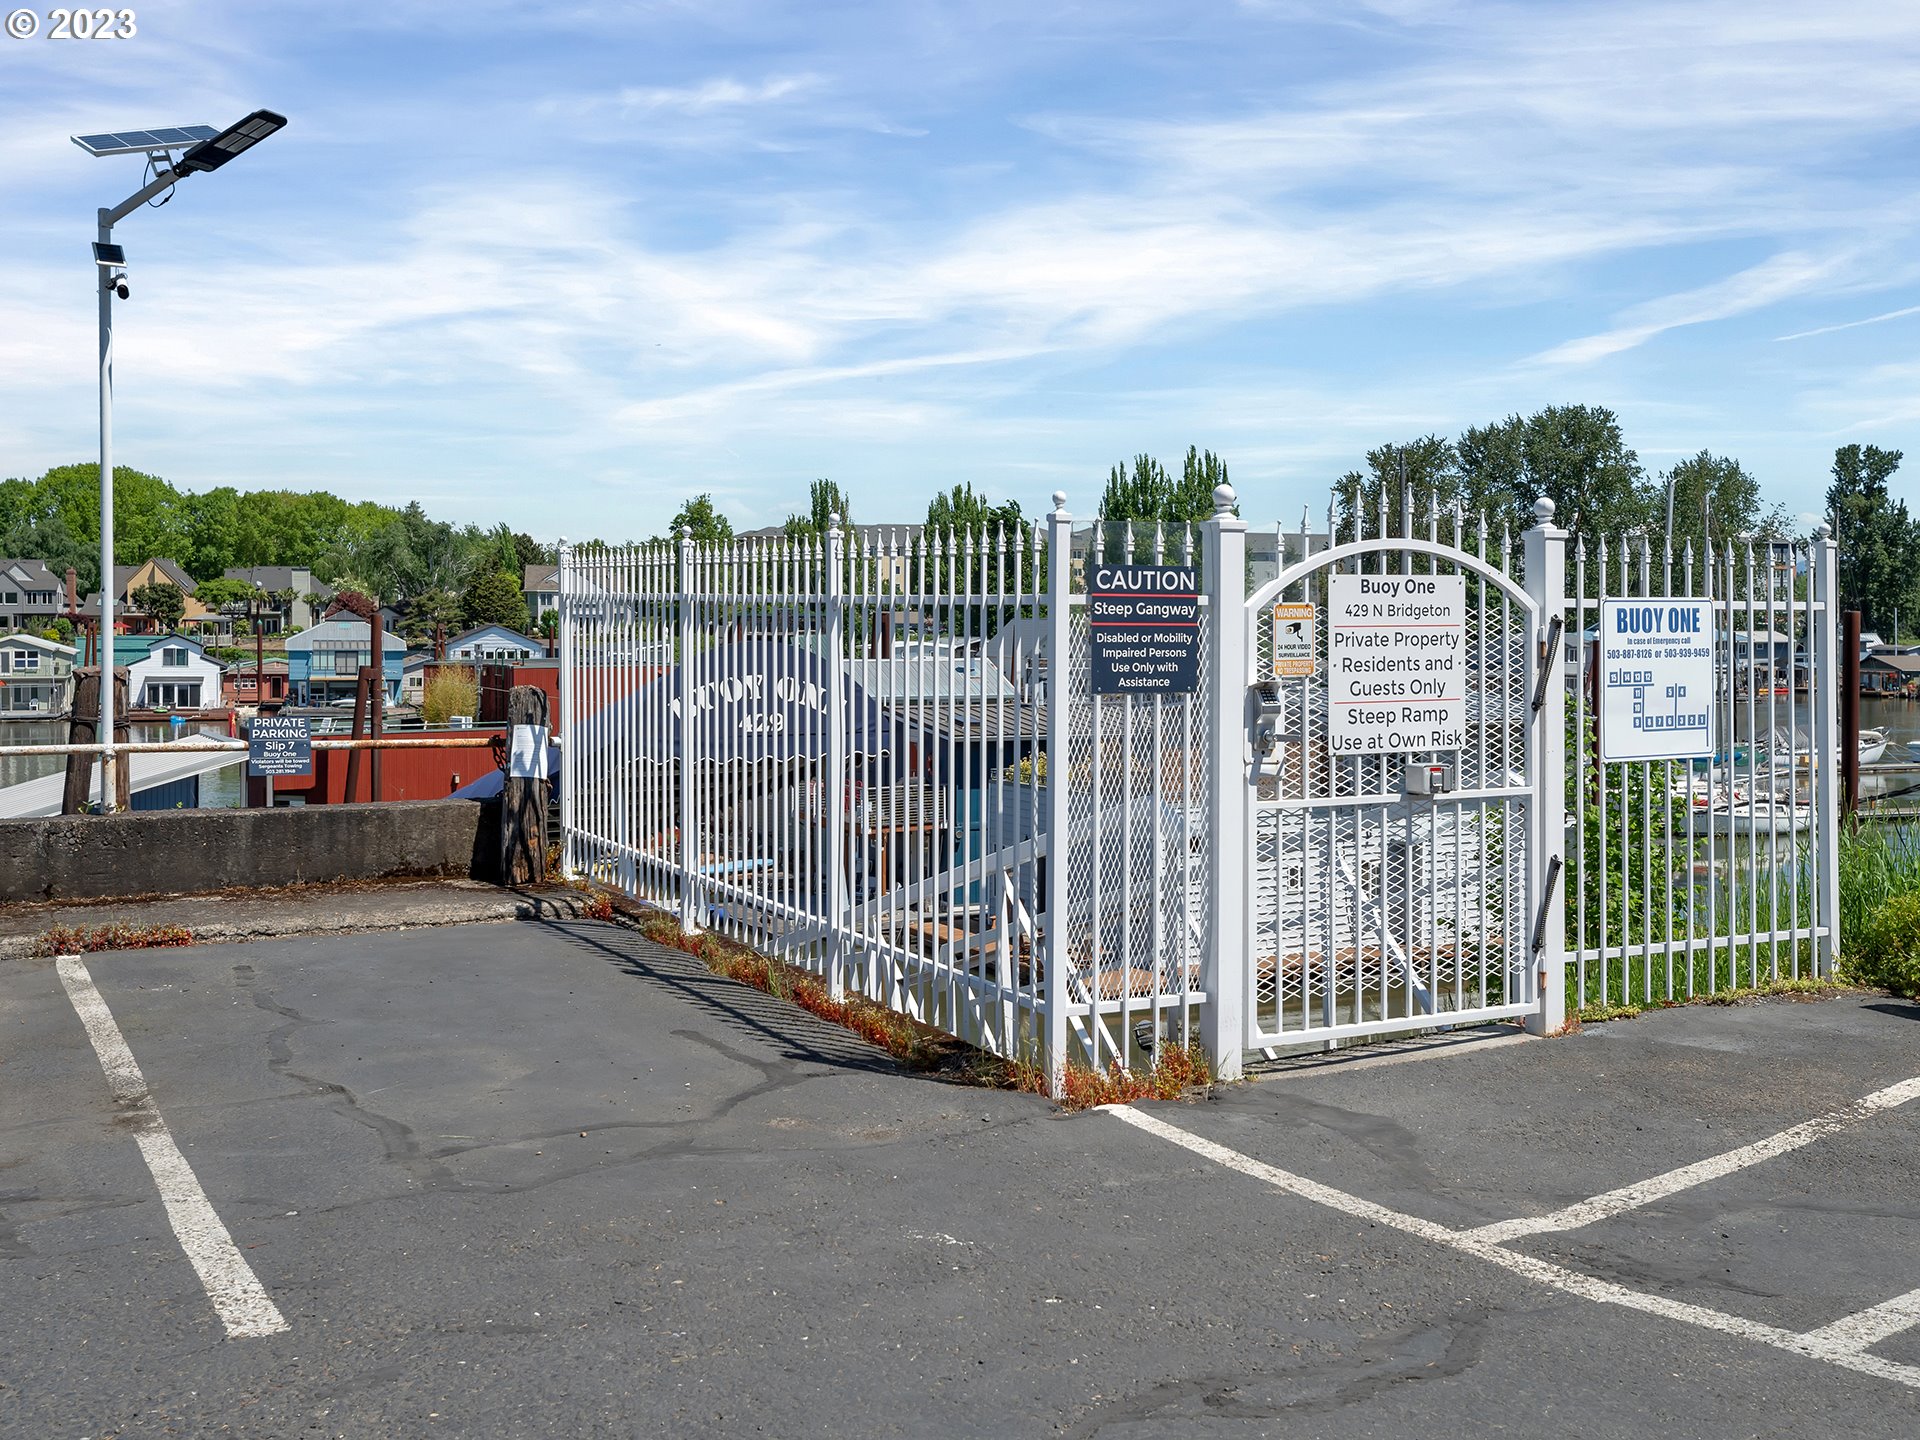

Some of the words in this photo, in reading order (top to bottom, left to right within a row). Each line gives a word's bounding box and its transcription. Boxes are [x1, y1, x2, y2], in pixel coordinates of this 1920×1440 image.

[1096, 570, 1194, 590] CAUTION
[1361, 579, 1400, 597] Buoy
[1405, 579, 1435, 594] One
[1094, 602, 1132, 617] Steep
[1136, 603, 1195, 618] Gangway
[1277, 608, 1312, 617] WARNING
[1346, 604, 1368, 617] 429
[1373, 605, 1382, 617] N
[1388, 604, 1450, 619] Bridgeton
[1617, 608, 1664, 633] BUOY
[1668, 608, 1700, 633] ONE
[1097, 633, 1138, 643] Disabled
[1154, 633, 1192, 645] Mobility
[1335, 632, 1389, 647] Private
[1394, 632, 1459, 649] Property
[1103, 648, 1146, 659] Impaired
[1150, 648, 1187, 657] Persons
[1607, 649, 1652, 659] 503-887-8126
[1664, 648, 1710, 658] 503-939-9459
[1112, 663, 1130, 672] Use
[1132, 662, 1155, 674] Only
[1157, 662, 1178, 672] with
[1343, 657, 1420, 672] Residents
[1424, 655, 1453, 671] and
[1118, 677, 1170, 687] Assistance
[1350, 680, 1405, 696] Guests
[1410, 678, 1446, 697] Only
[777, 676, 848, 719] ON
[254, 718, 305, 727] PRIVATE
[1348, 709, 1396, 726] Steep
[1402, 707, 1448, 724] Ramp
[252, 729, 307, 738] PARKING
[1332, 735, 1362, 750] Use
[1368, 734, 1384, 749] at
[1389, 732, 1426, 747] Own
[1432, 729, 1462, 746] Risk
[266, 741, 285, 751] Slip
